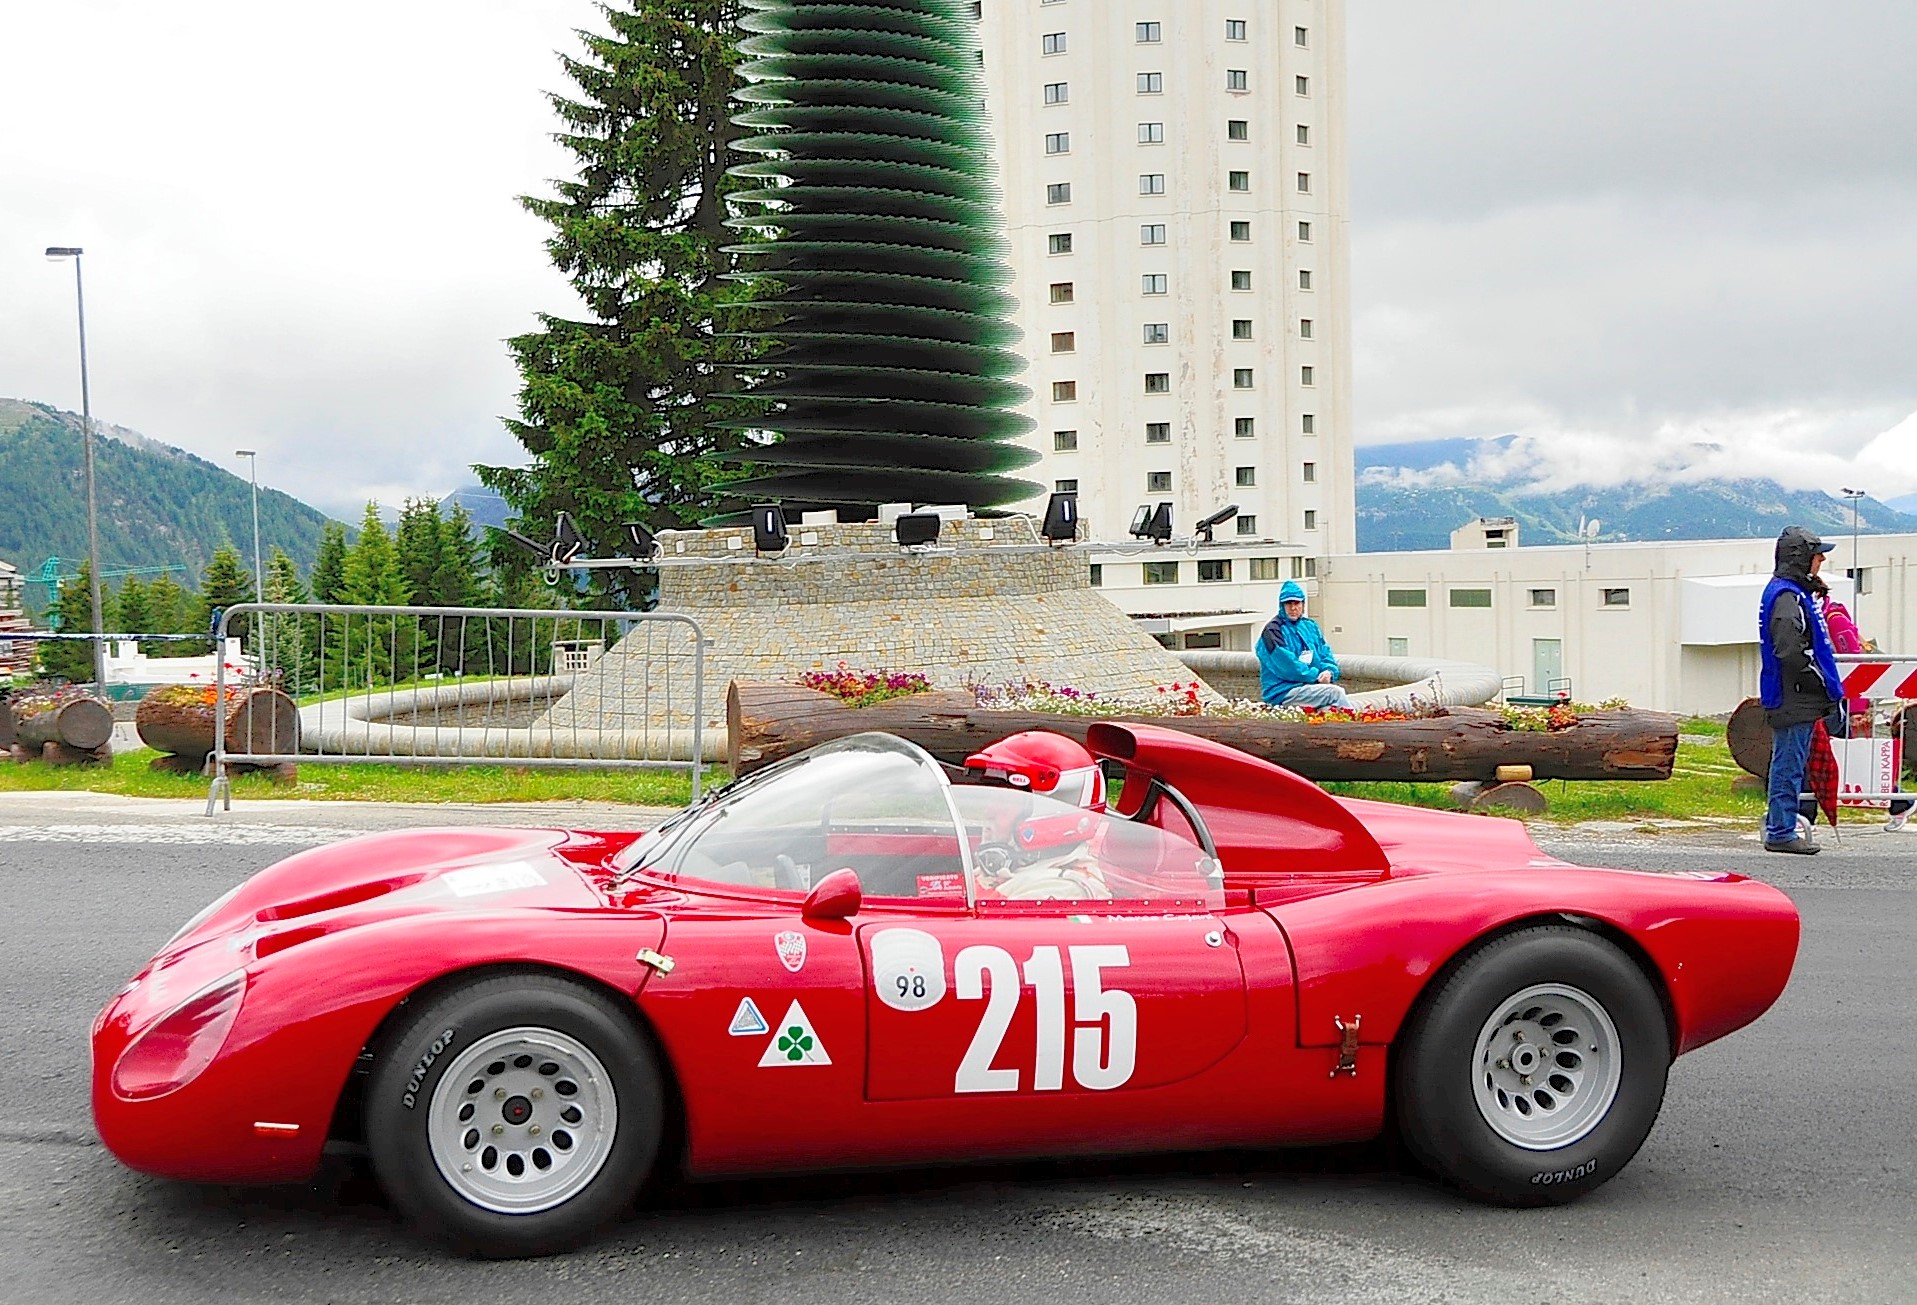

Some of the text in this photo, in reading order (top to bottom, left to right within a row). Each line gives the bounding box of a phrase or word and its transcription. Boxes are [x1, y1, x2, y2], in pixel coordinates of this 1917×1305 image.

[1880, 741, 1890, 807] RBE DI KAPPA
[896, 975, 926, 998] 98
[954, 944, 1138, 1094] 215
[402, 1029, 454, 1109] DUNLOP
[1531, 1159, 1596, 1185] DUNLOP
